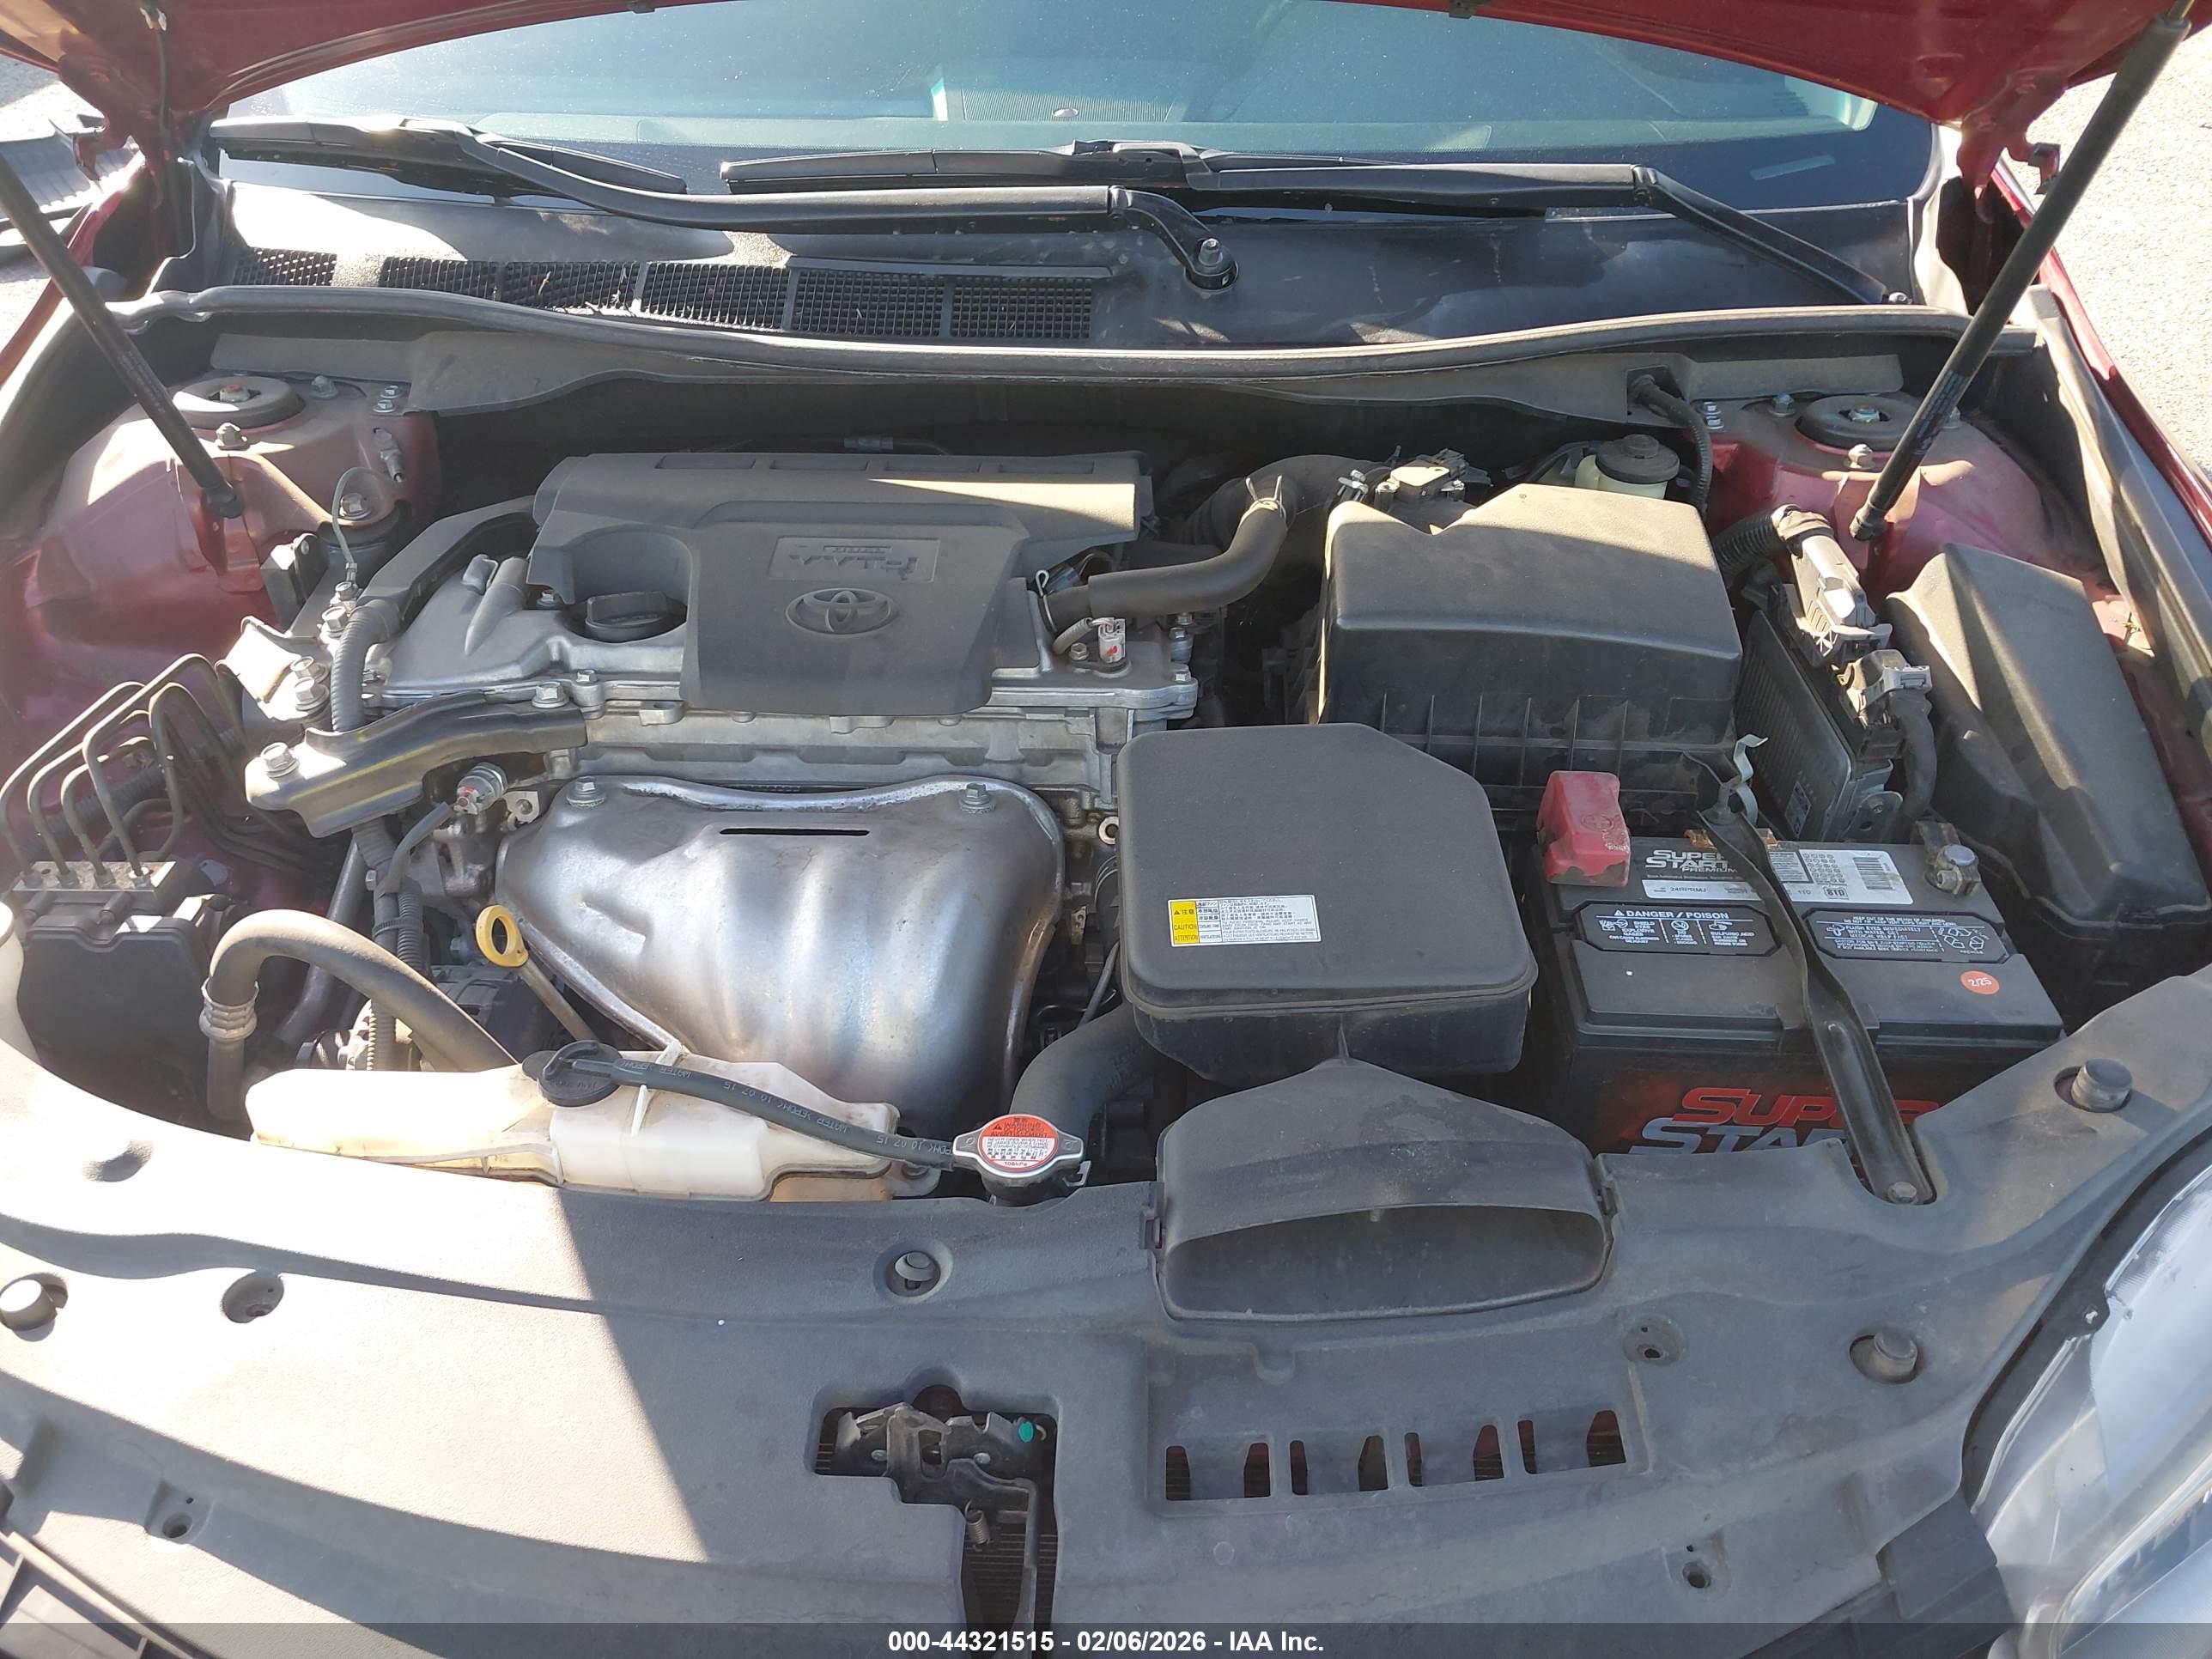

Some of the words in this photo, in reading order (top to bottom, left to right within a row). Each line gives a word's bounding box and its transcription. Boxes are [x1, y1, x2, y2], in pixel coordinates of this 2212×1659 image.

[1645, 857, 1729, 868] START
[659, 1066, 693, 1079] WATER
[721, 1079, 738, 1091] 15
[741, 1086, 757, 1098] 07
[760, 1093, 774, 1104] 10
[1672, 1086, 1939, 1128] SUP
[816, 1115, 848, 1136] WATER
[875, 1134, 889, 1145] 15
[1628, 1117, 1849, 1156] STA
[893, 1139, 908, 1148] 07
[910, 1139, 924, 1151] 10
[927, 1141, 952, 1156] PDM<
